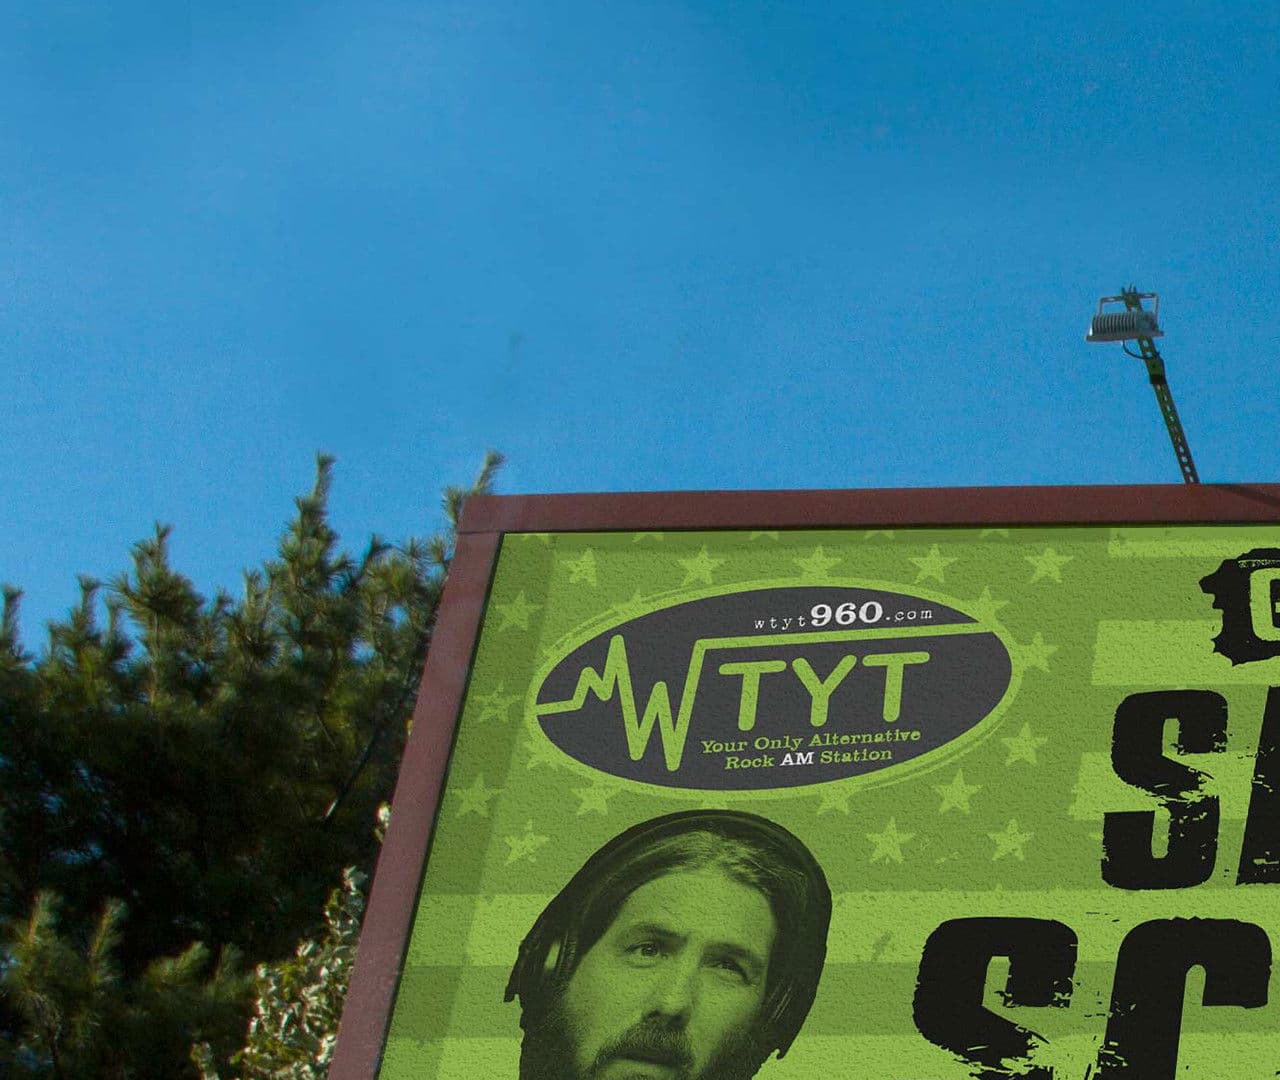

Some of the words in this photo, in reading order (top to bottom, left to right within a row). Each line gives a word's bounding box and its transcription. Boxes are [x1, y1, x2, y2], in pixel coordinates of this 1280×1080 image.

[754, 601, 933, 630] wtyt960.com
[606, 634, 931, 771] WTYT
[700, 739, 748, 754] Your
[754, 735, 803, 751] Only
[808, 728, 921, 748] Alternative
[724, 754, 775, 770] Rock
[779, 751, 814, 767] AM
[820, 748, 892, 764] Station
